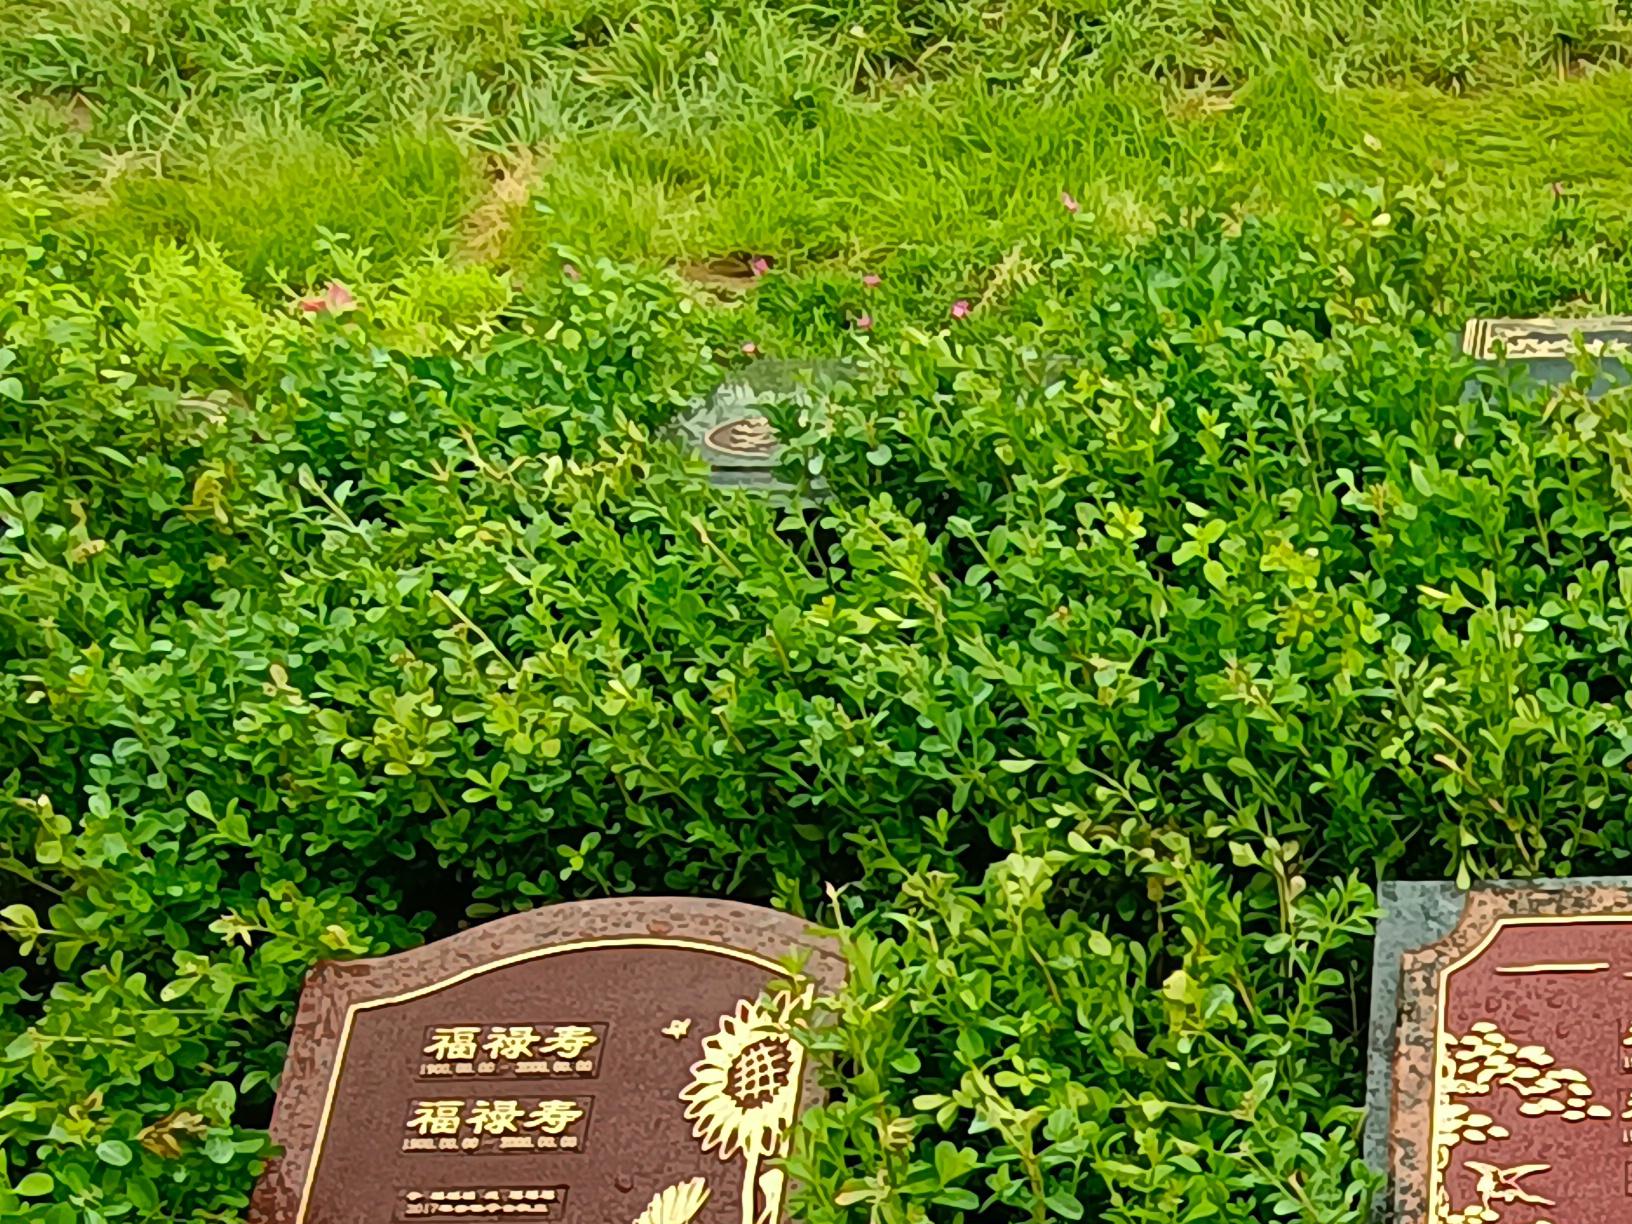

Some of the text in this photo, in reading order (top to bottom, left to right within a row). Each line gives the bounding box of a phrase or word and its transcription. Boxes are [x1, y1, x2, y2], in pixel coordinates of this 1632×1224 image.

[423, 1025, 598, 1061] 福禄寿
[406, 1099, 584, 1135] 福禄寿
